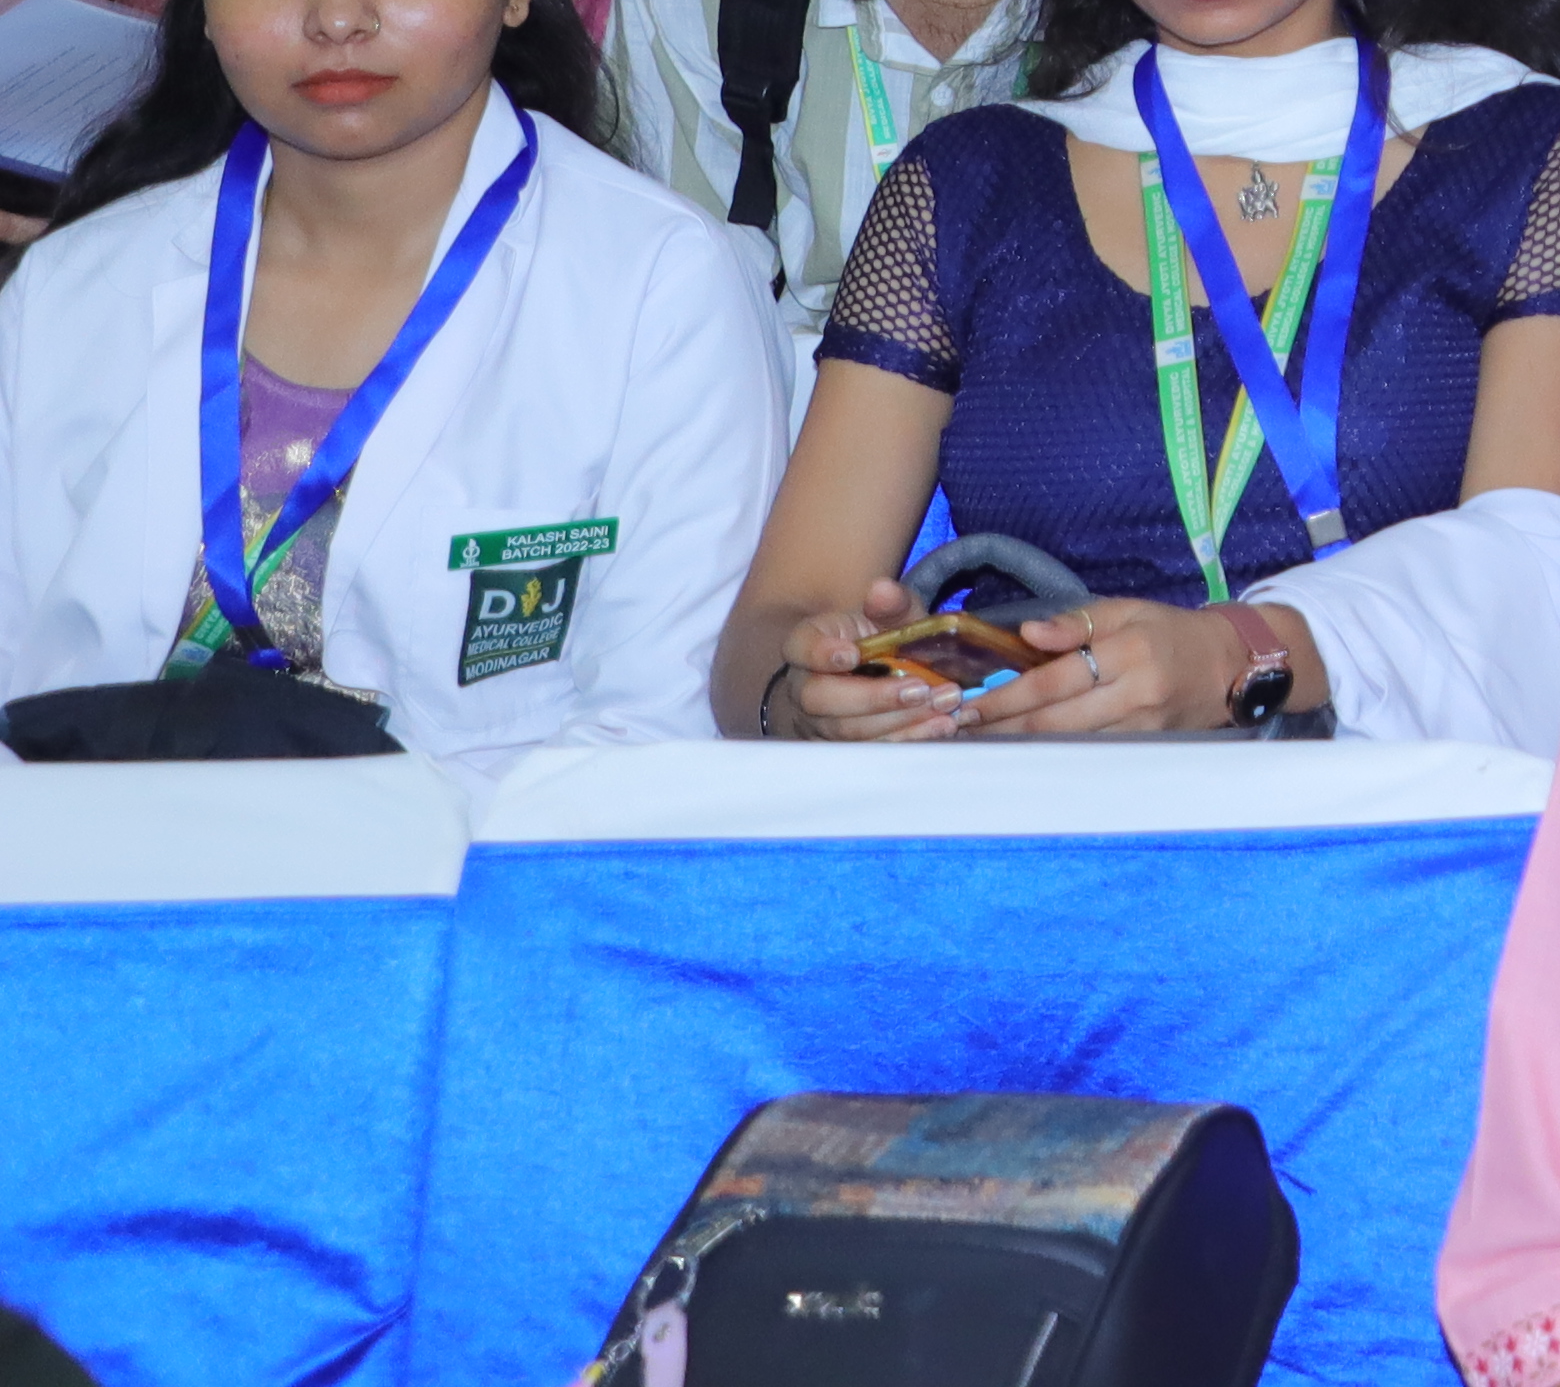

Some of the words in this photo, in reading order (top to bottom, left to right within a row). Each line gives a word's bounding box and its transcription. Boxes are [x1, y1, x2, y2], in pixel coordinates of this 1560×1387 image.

[1152, 191, 1168, 257] AYURVEDIC
[1290, 207, 1314, 273] AYURVEDIC
[1159, 260, 1170, 295] JYOTI
[1163, 297, 1174, 335] DIVYA
[1170, 371, 1187, 448] AYURVEDIC
[502, 541, 551, 561] BATCH
[555, 537, 610, 555] 2022-23
[506, 529, 566, 548] KALASH
[569, 525, 609, 541] SAINI
[478, 589, 516, 620] D
[541, 578, 566, 613] J
[467, 635, 511, 656] MEDICAL
[513, 627, 561, 649] COLLEGE
[471, 613, 563, 641] AYURVEDIC
[465, 646, 550, 681] MODINAGAR
